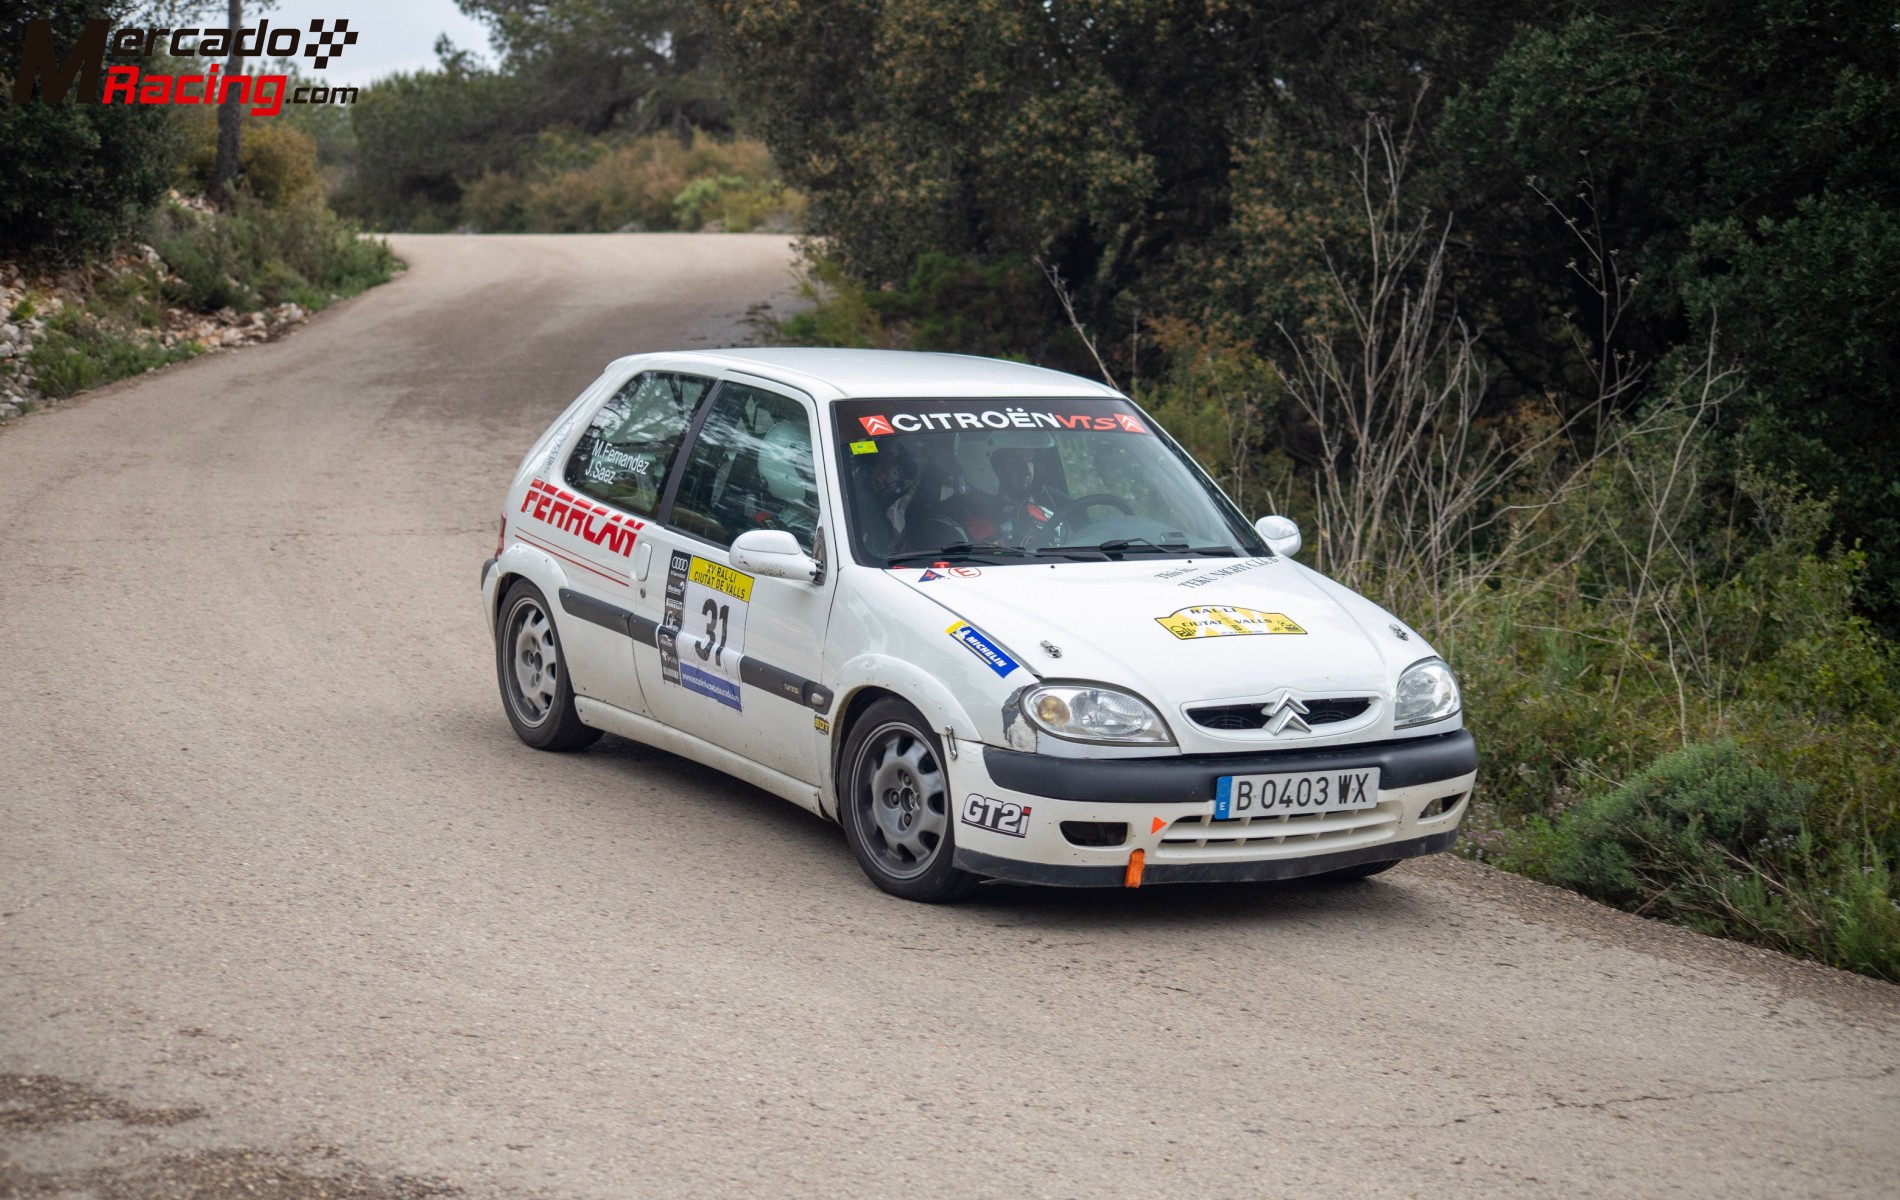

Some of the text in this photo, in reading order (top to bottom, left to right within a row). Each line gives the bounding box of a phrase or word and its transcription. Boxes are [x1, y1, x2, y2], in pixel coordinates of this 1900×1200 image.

[694, 571, 745, 599] CIUTAT DE VALLS
[695, 598, 729, 667] 31
[966, 636, 1007, 667] MICHELIN
[1219, 801, 1226, 811] E
[1236, 773, 1369, 811] B 0403 WX
[961, 792, 1032, 835] GT2i
